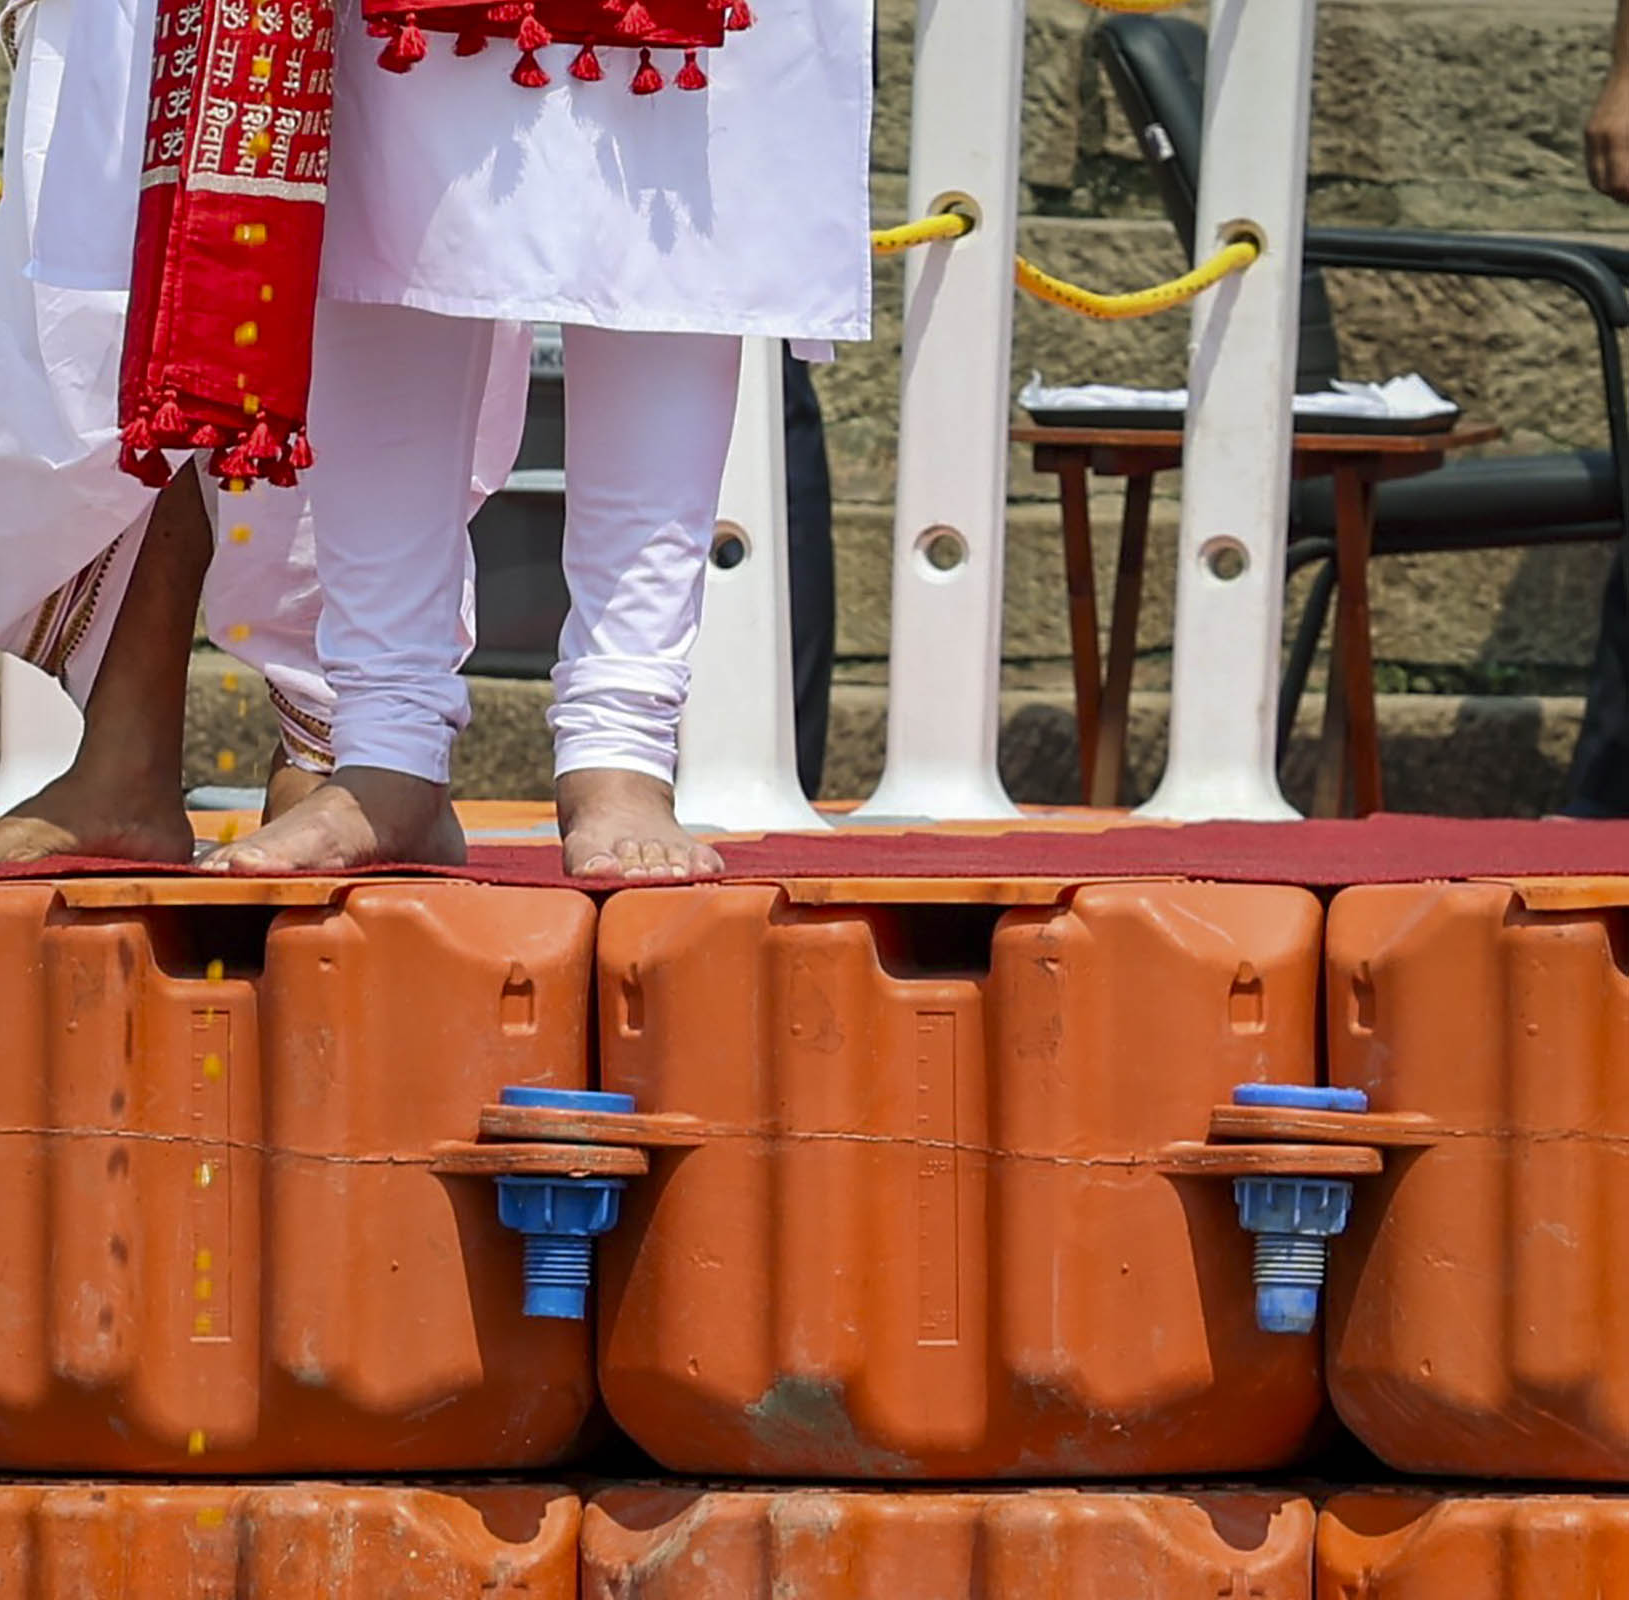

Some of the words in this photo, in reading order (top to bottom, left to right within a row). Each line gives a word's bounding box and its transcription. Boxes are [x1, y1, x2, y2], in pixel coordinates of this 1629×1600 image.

[291, 2, 313, 40] ॐ
[210, 35, 239, 87] नमः
[283, 50, 305, 97] नमः
[195, 94, 240, 174] शिवाय
[265, 105, 305, 182] शिवाय
